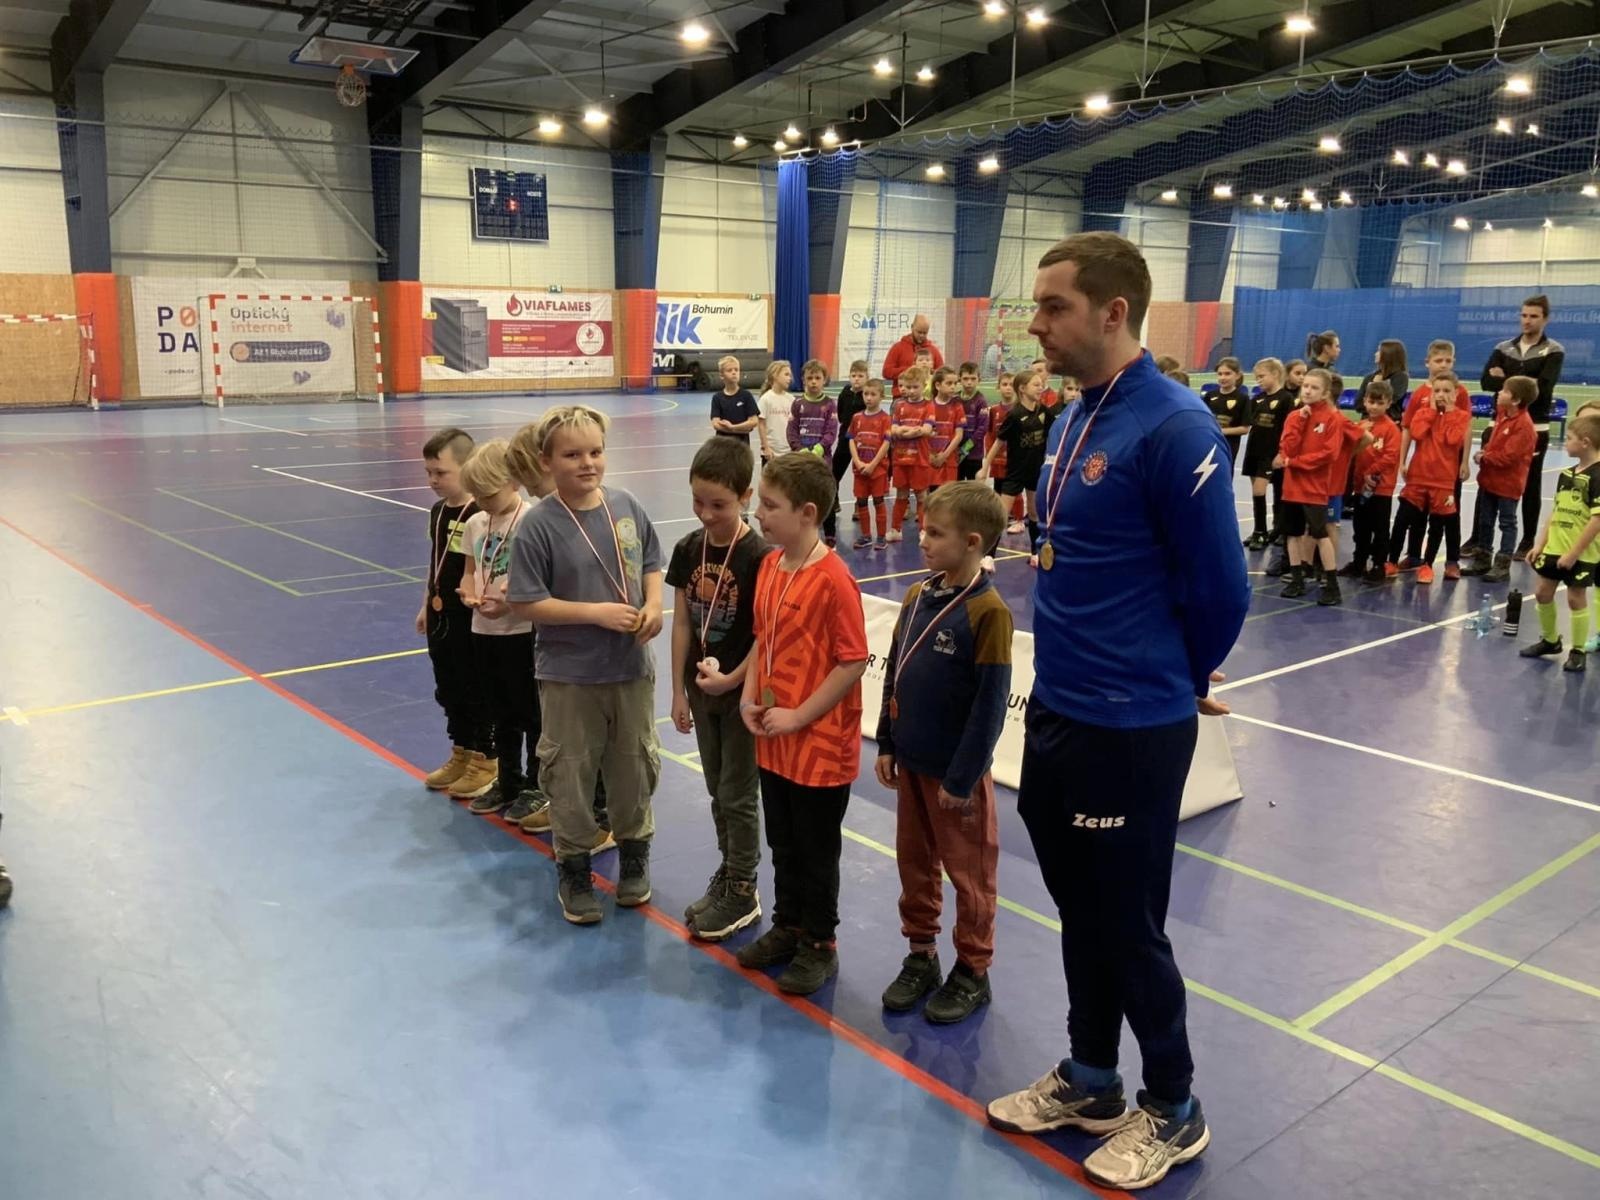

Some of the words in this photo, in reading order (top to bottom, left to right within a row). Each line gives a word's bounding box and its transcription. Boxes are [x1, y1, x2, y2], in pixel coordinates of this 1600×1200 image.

[523, 299, 592, 312] VIAFLAMES
[230, 306, 290, 322] Optický
[231, 321, 294, 333] internet
[1072, 812, 1126, 829] Zeus
